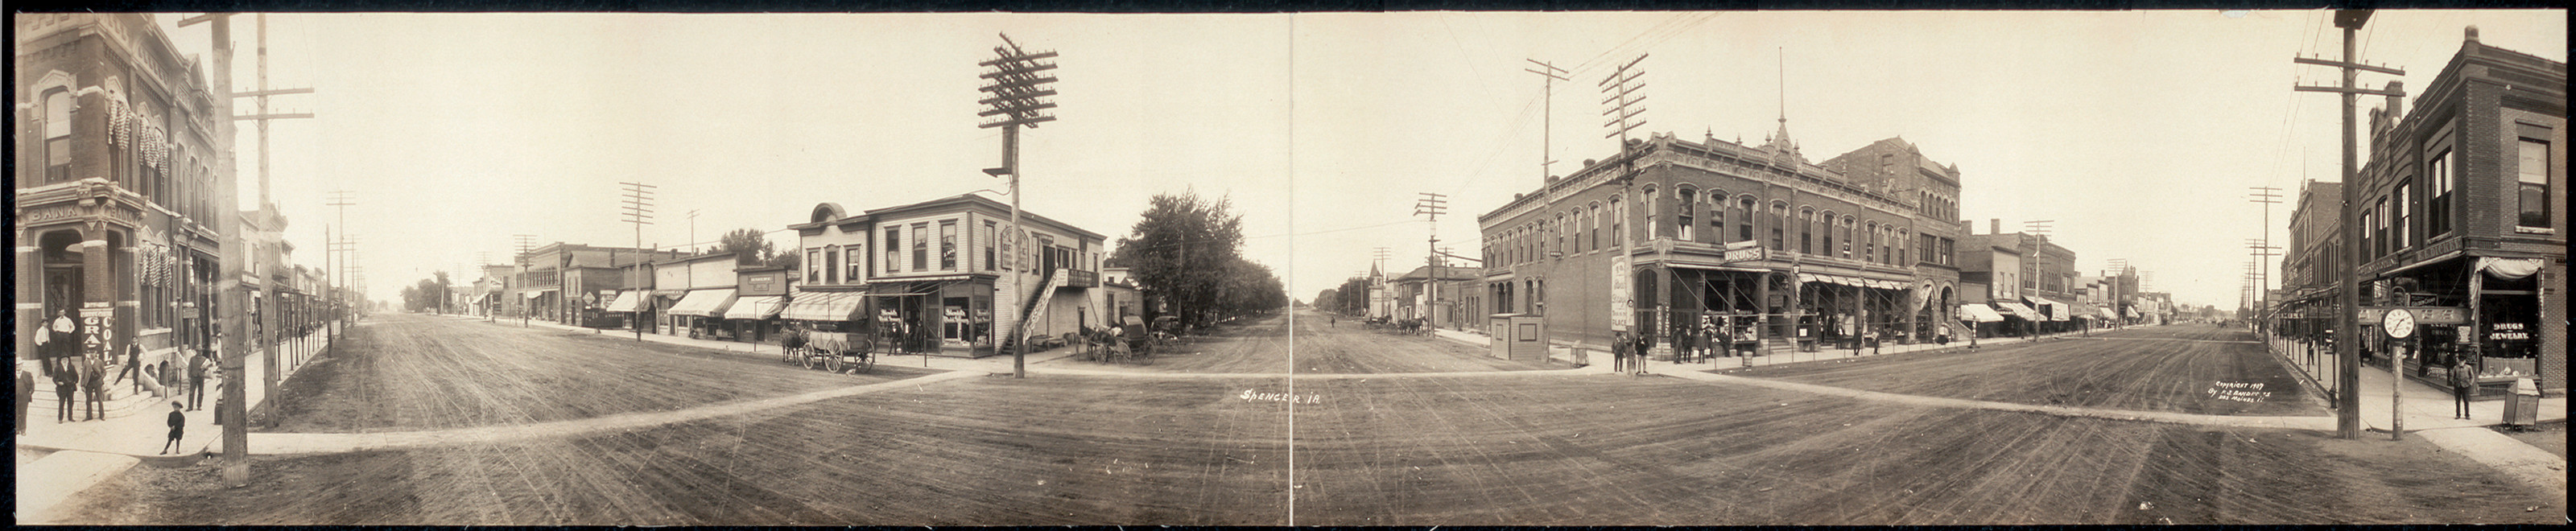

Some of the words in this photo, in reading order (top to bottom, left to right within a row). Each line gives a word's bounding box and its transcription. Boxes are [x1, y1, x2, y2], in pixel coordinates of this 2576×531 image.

[31, 205, 77, 221] BANK
[110, 207, 134, 224] BANK
[1725, 249, 1760, 261] DRUGS
[2493, 323, 2524, 331] DRUGS
